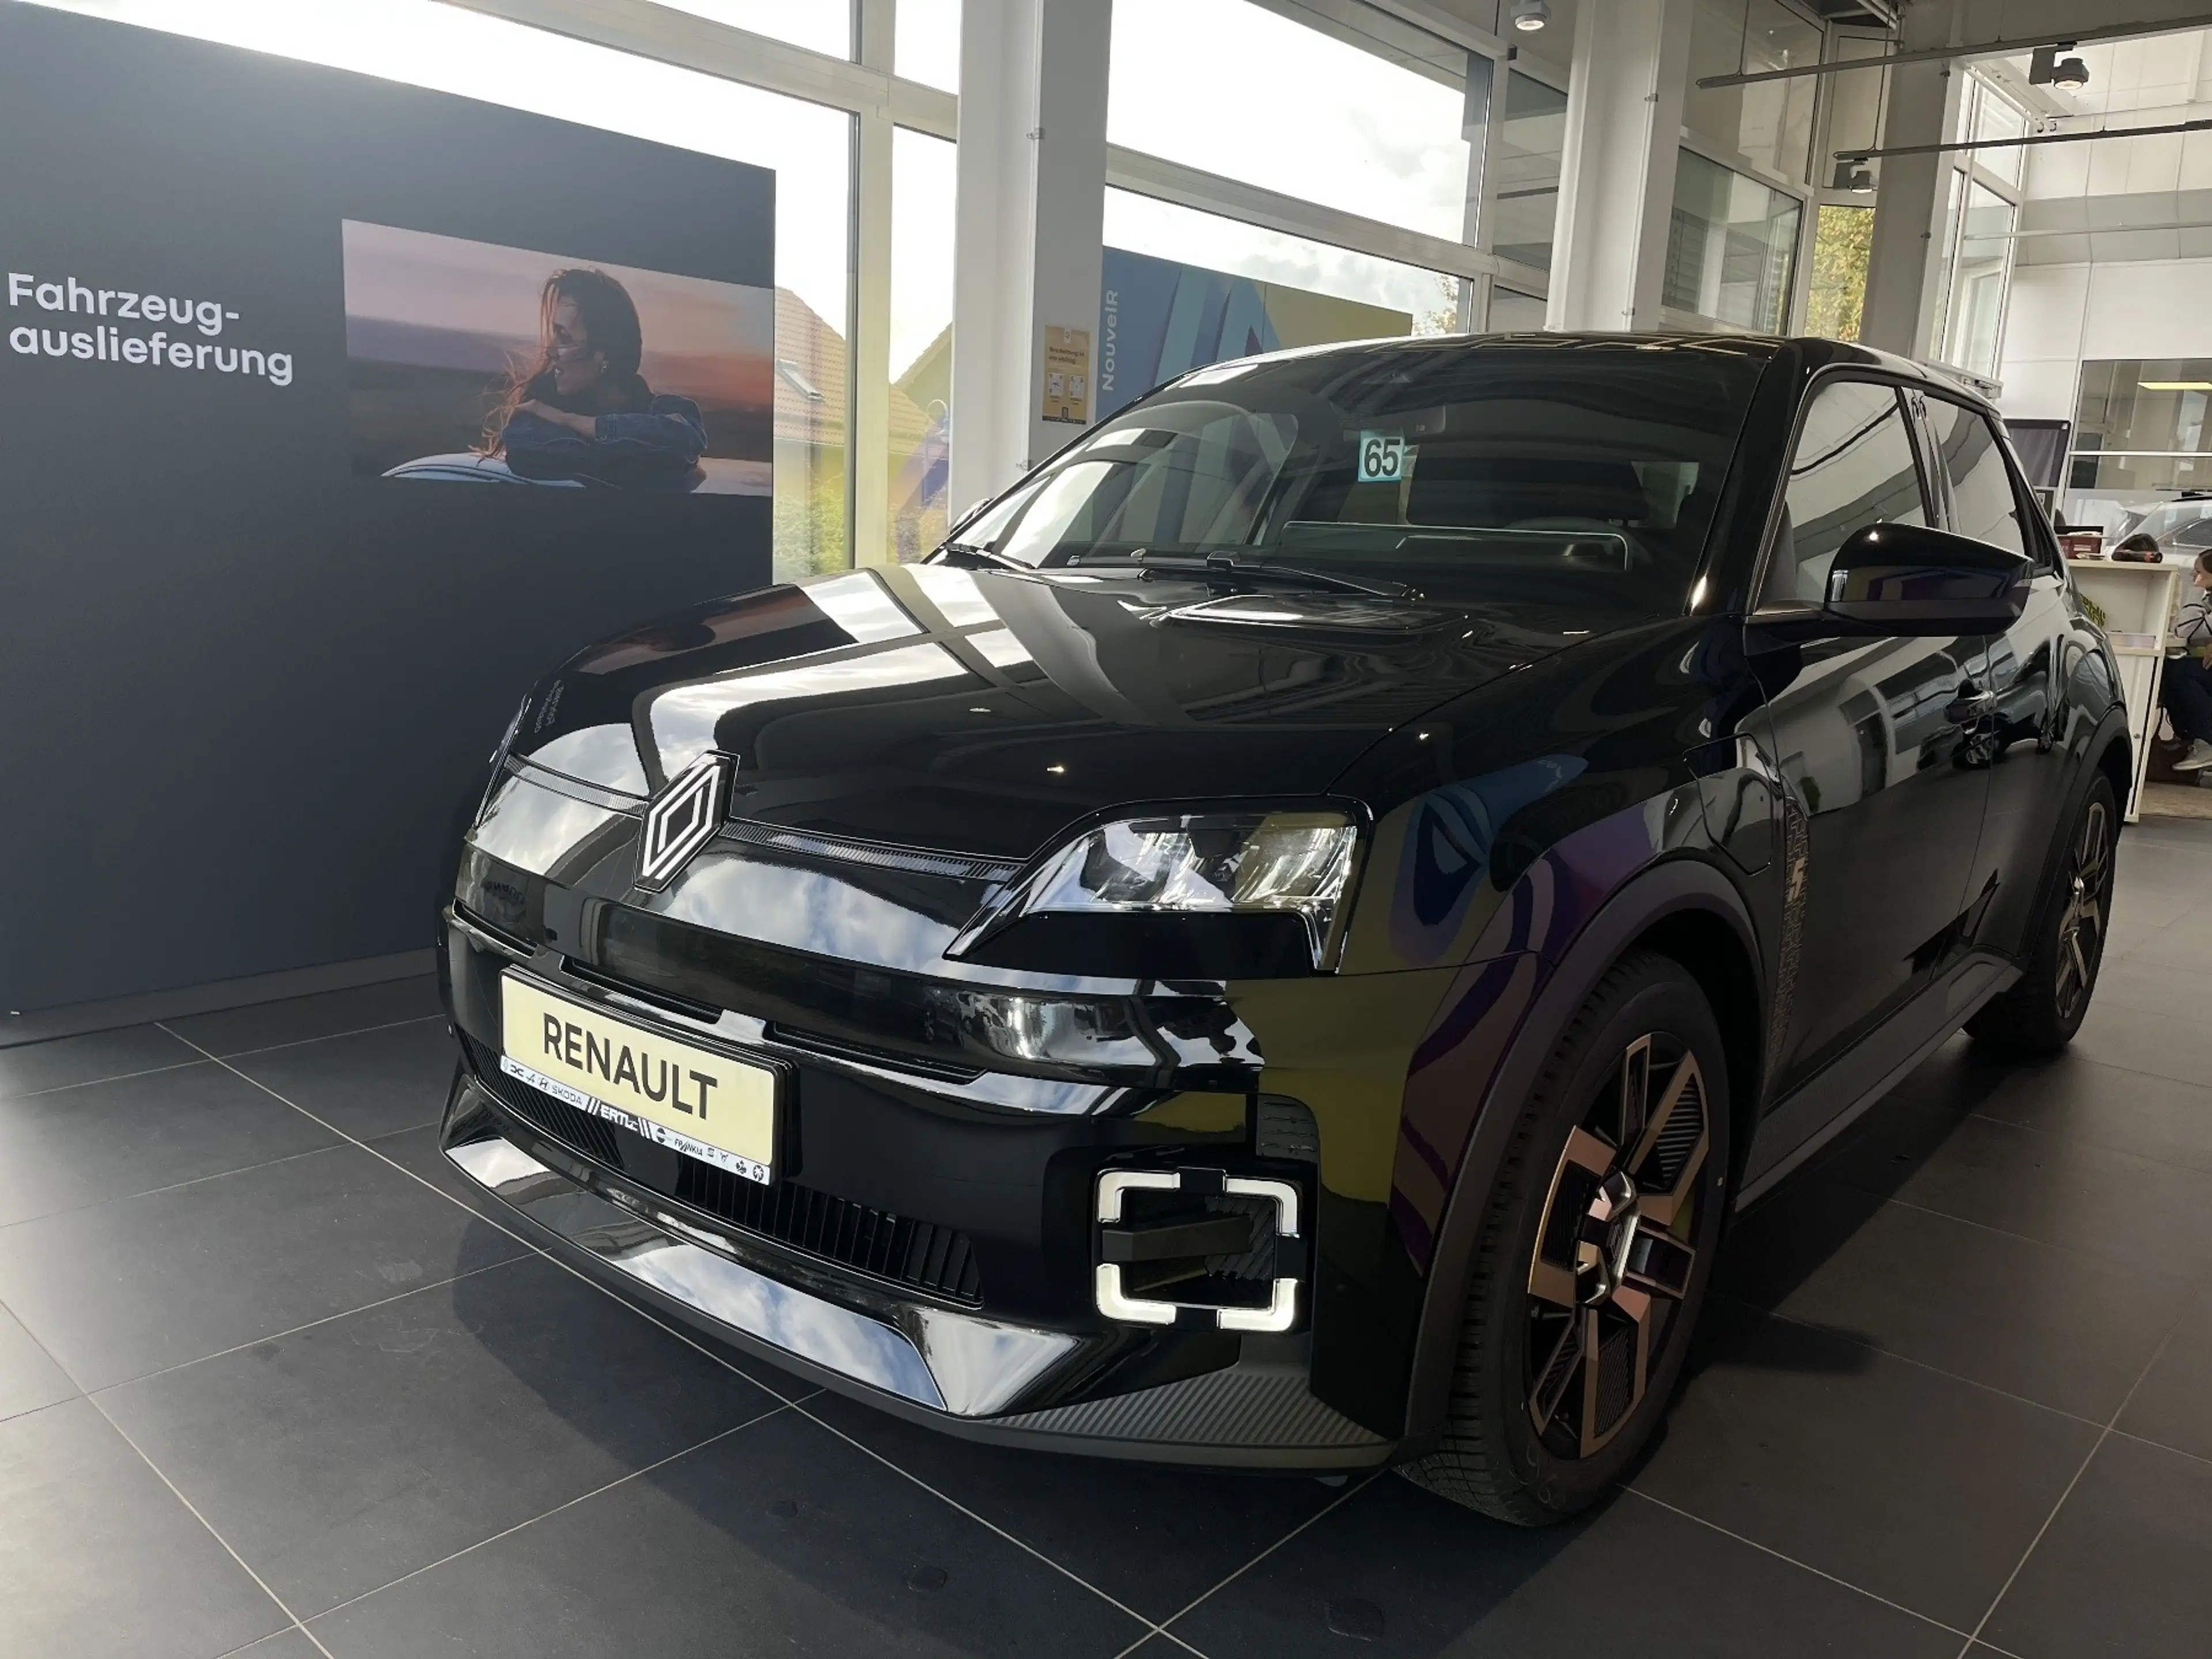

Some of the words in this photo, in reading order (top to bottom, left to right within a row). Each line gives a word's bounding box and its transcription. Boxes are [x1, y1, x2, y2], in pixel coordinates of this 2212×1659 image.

[8, 272, 240, 336] Fahrzeug-
[9, 325, 293, 386] auslieferung
[1364, 438, 1400, 478] 65
[544, 1012, 718, 1120] RENAULT
